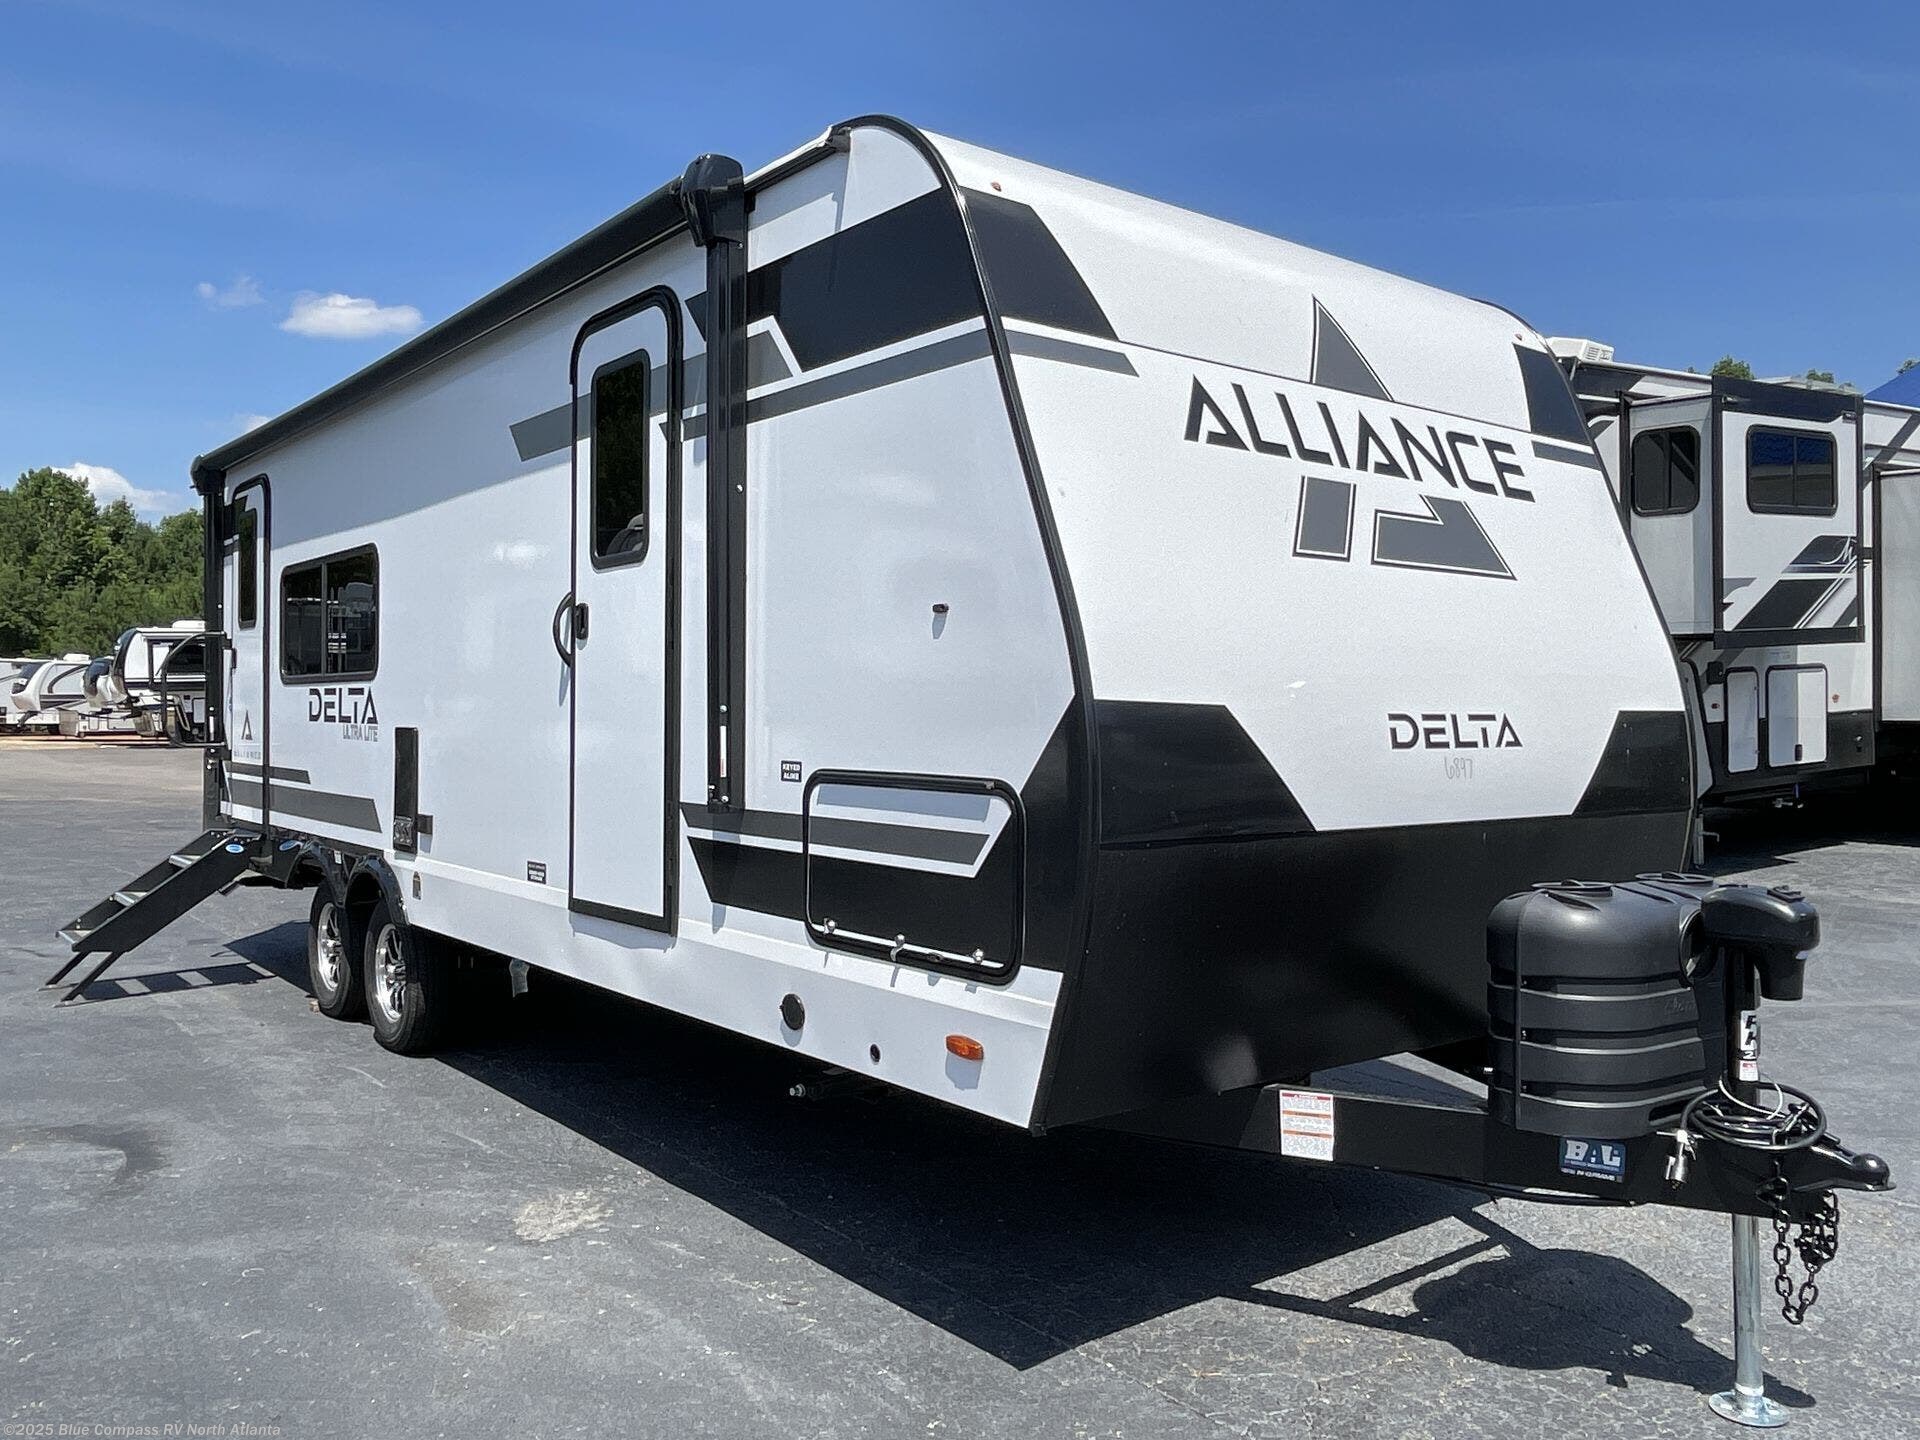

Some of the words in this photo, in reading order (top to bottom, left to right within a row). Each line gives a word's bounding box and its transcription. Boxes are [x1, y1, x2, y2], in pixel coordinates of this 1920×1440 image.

[1184, 374, 1536, 503] ALLIANCE
[309, 686, 378, 725] DELTA
[343, 724, 363, 741] ULTRA
[364, 725, 378, 742] LITE
[1387, 713, 1523, 750] DELTA
[1444, 755, 1474, 780] 6897
